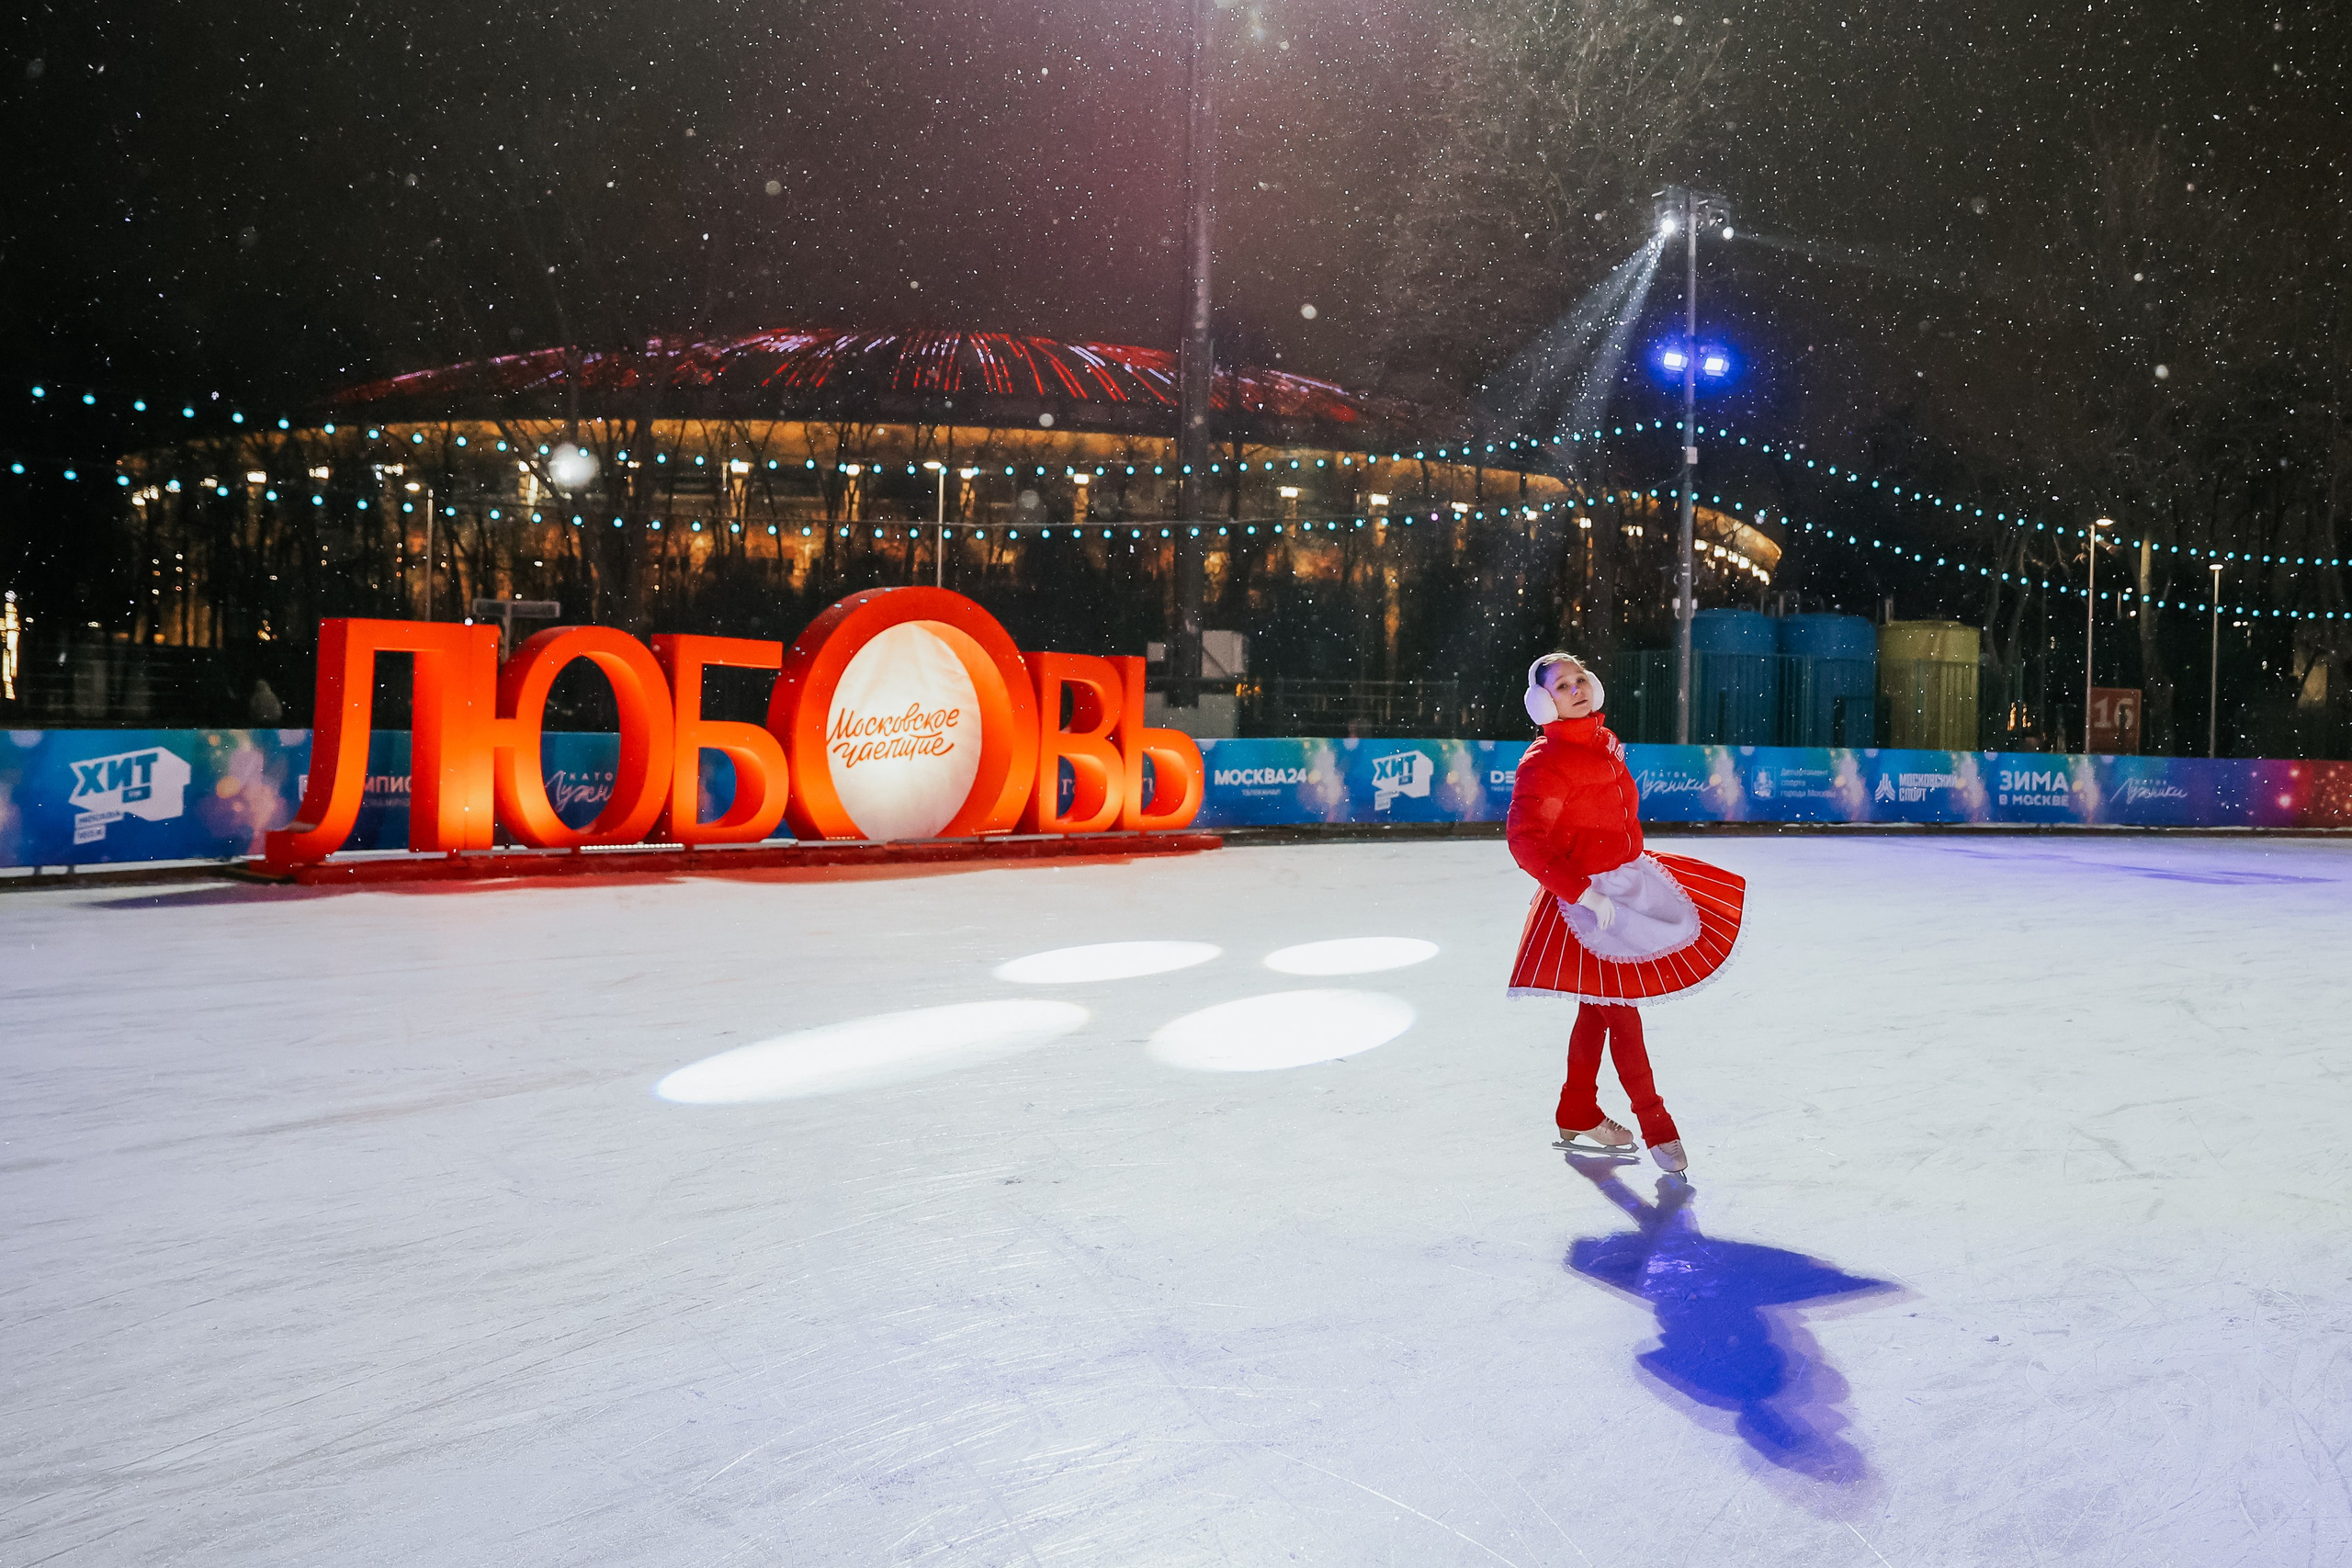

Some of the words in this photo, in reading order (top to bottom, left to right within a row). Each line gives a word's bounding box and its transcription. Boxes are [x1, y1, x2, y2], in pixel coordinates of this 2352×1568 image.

[266, 584, 1204, 863] ЛЮБОВЬ
[826, 702, 960, 744] Московское
[77, 752, 158, 796] ХИТ
[1214, 767, 1307, 785] МОСКВА24
[1376, 754, 1417, 781] ХИТ
[1489, 770, 1517, 784] DE
[1999, 771, 2068, 792] ЗИМА
[1898, 787, 1928, 802] СПОРТ
[1998, 795, 2008, 806] В
[2012, 795, 2069, 807] МОСКВЕ
